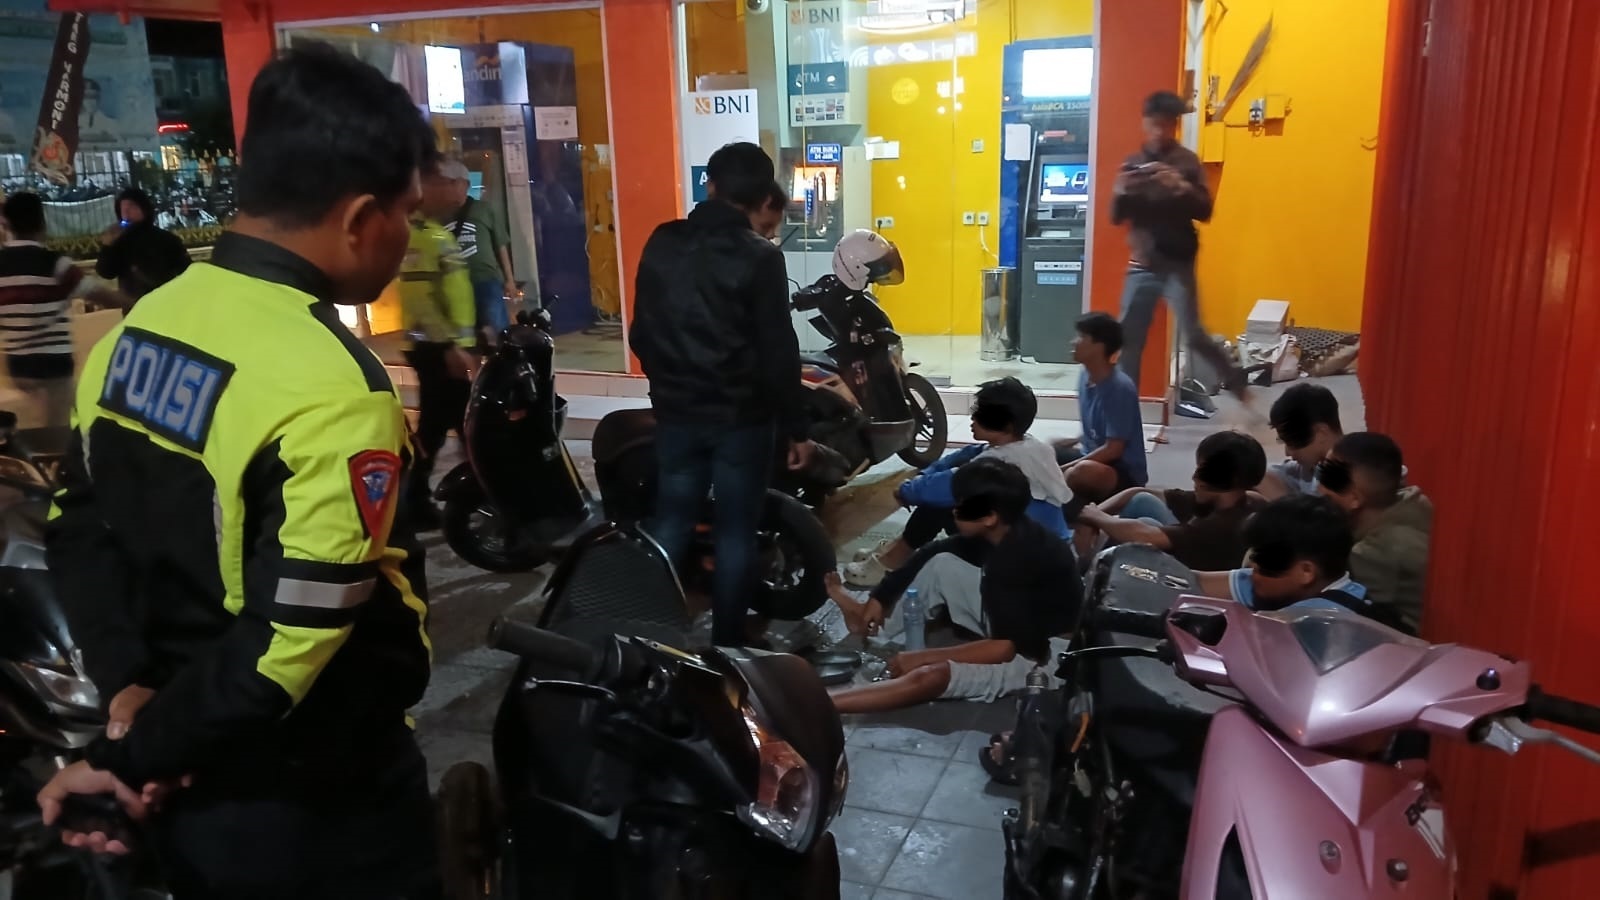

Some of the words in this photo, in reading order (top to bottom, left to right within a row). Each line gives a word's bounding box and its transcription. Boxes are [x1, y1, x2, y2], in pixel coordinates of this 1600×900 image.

[808, 7, 840, 24] BNI
[796, 71, 820, 83] ATM
[714, 95, 750, 115] BNI
[104, 336, 221, 441] POLISI
